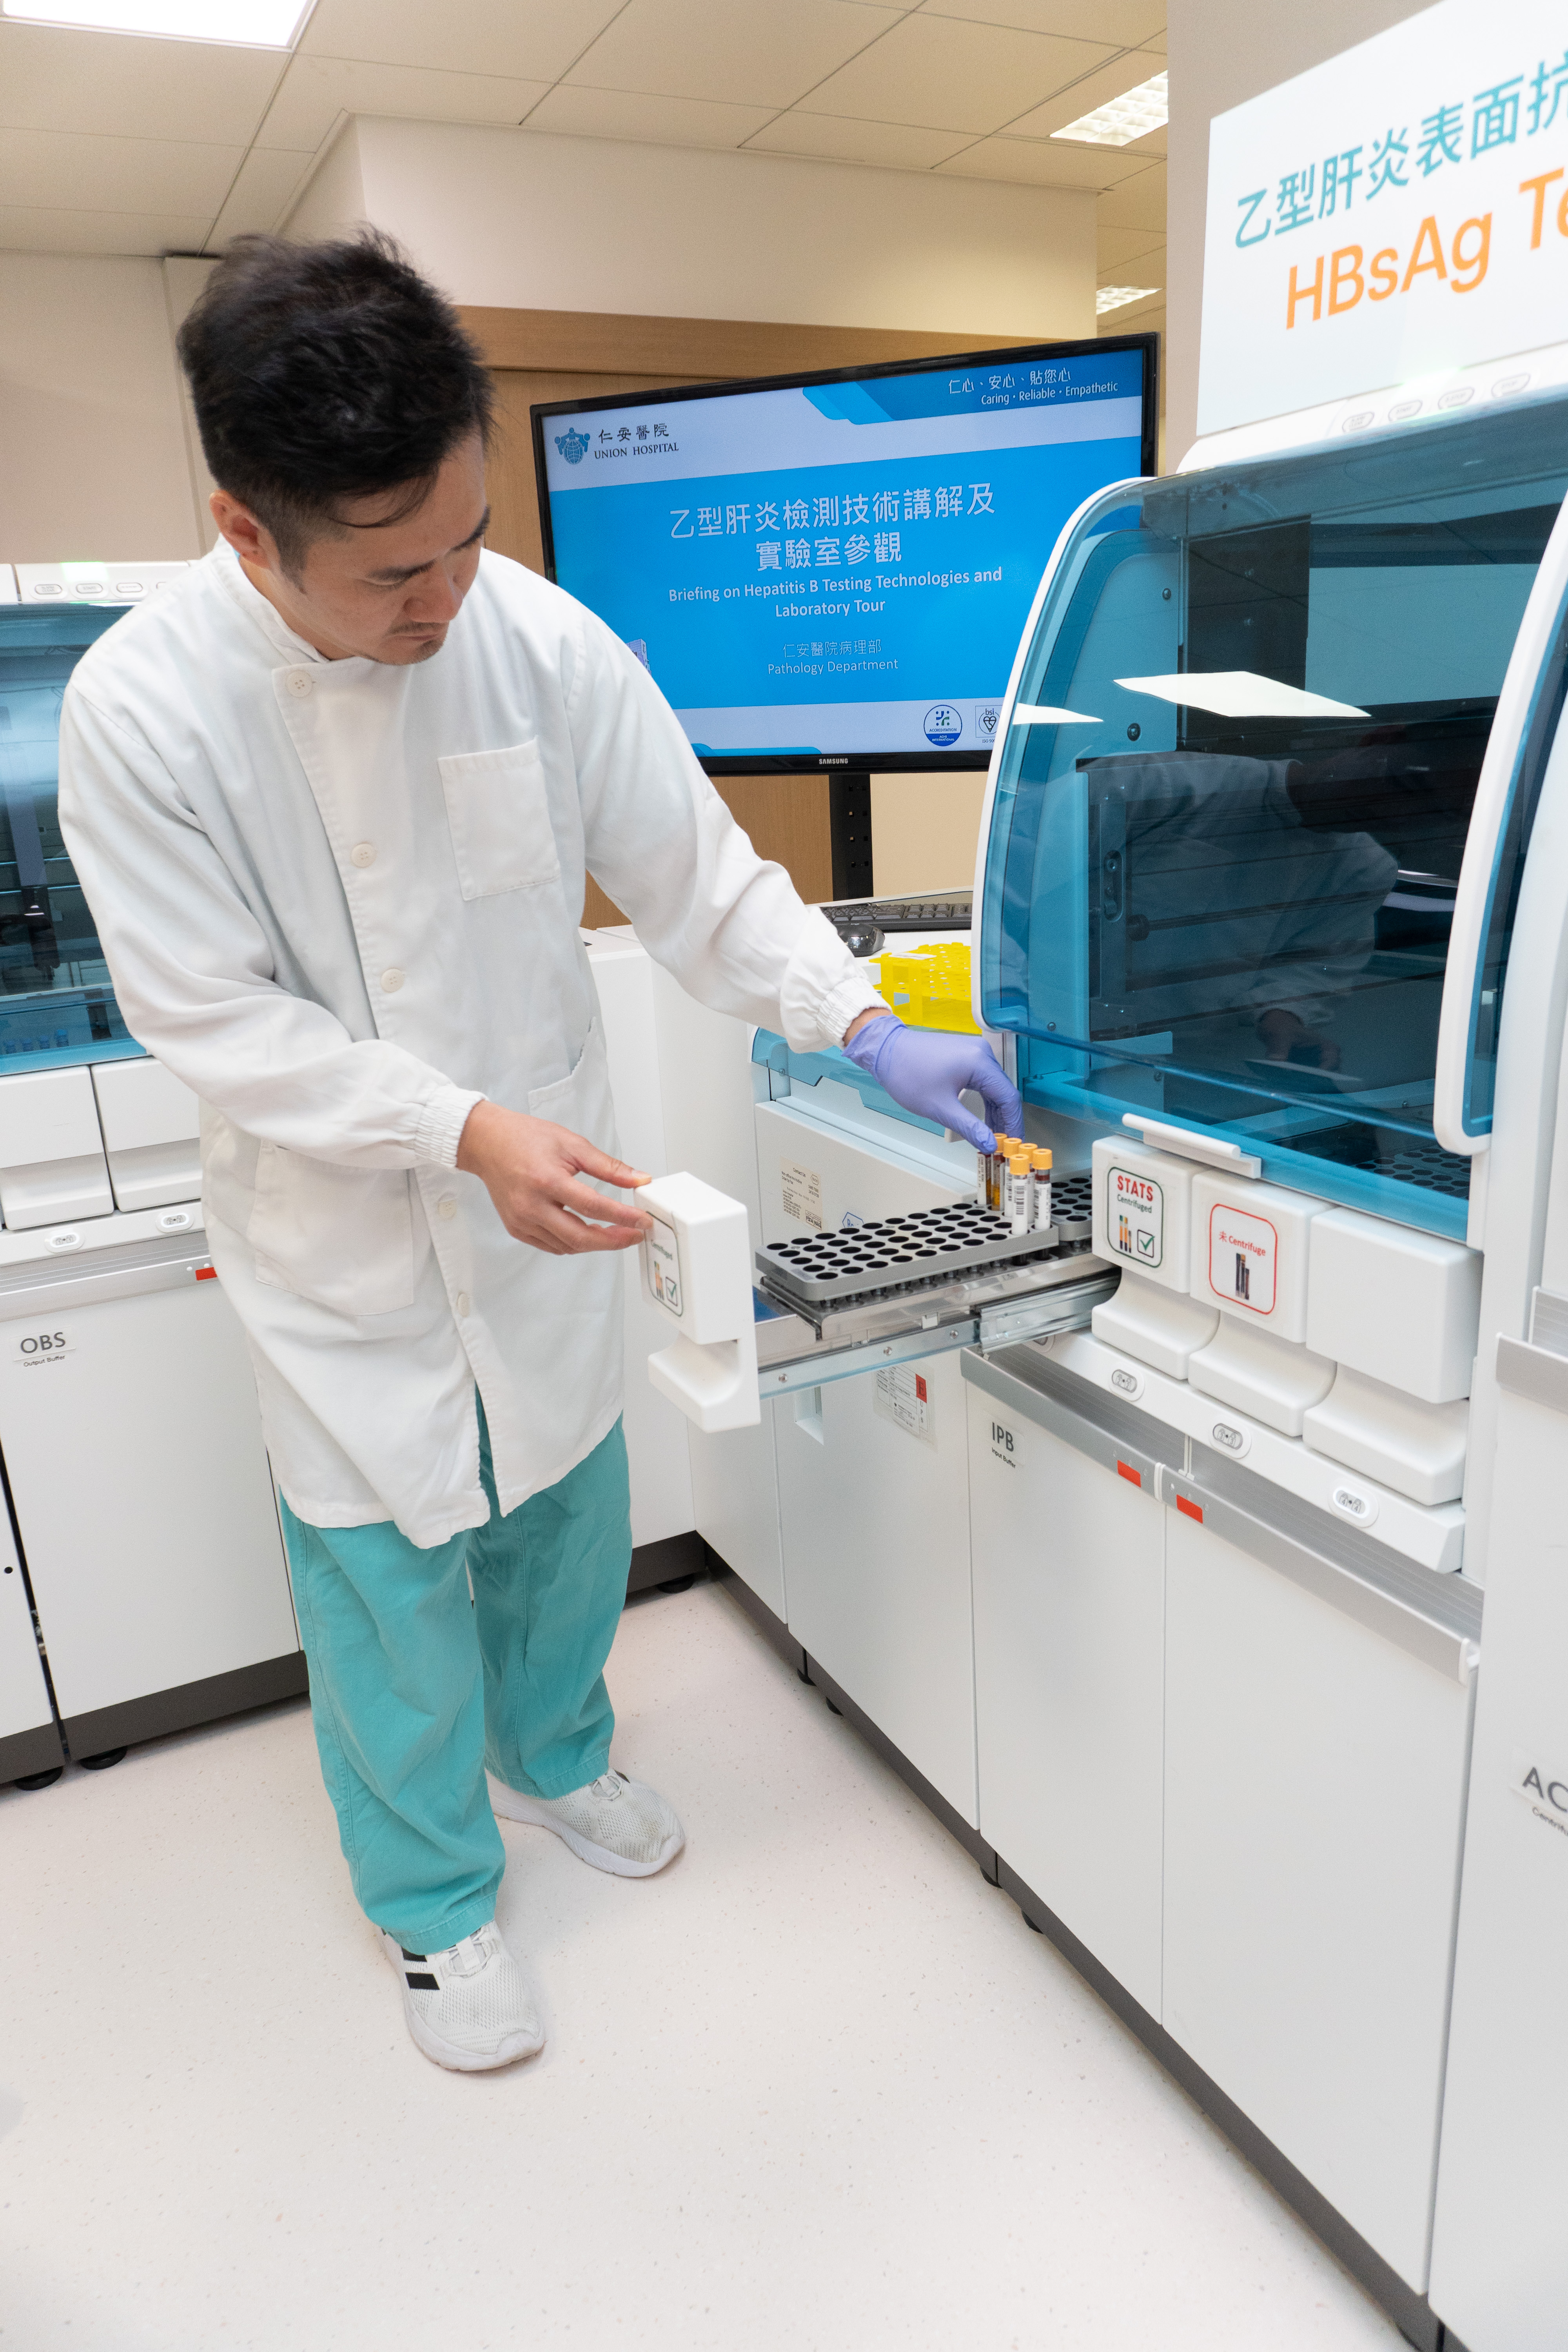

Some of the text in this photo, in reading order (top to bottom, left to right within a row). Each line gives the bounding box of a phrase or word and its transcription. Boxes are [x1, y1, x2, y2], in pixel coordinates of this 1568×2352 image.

[1286, 212, 1493, 330] HBsAg
[982, 381, 1118, 405] Caring Reliable Empathetic
[598, 423, 669, 444] 仁安醫院
[594, 442, 679, 459] UNION HOSPITAL
[669, 483, 995, 539] 乙型肝炎檢測技術講解及
[756, 532, 902, 572] 實驗室參觀
[669, 566, 1002, 602] Briefing on Hepatitis B Testing Technologies and
[775, 599, 886, 617] Laboratory Tour
[782, 639, 881, 658] 仁安醫院病理部
[768, 659, 898, 675] Pathology Department
[1117, 1175, 1153, 1202] STATS
[1117, 1194, 1152, 1213] Centrifuged
[1229, 1236, 1266, 1256] Centrifuge
[20, 1332, 66, 1354] OBS
[24, 1359, 45, 1367] Output
[918, 1381, 925, 1397] E
[992, 1422, 1014, 1452] IPB
[992, 1447, 1016, 1468] Input Buffer
